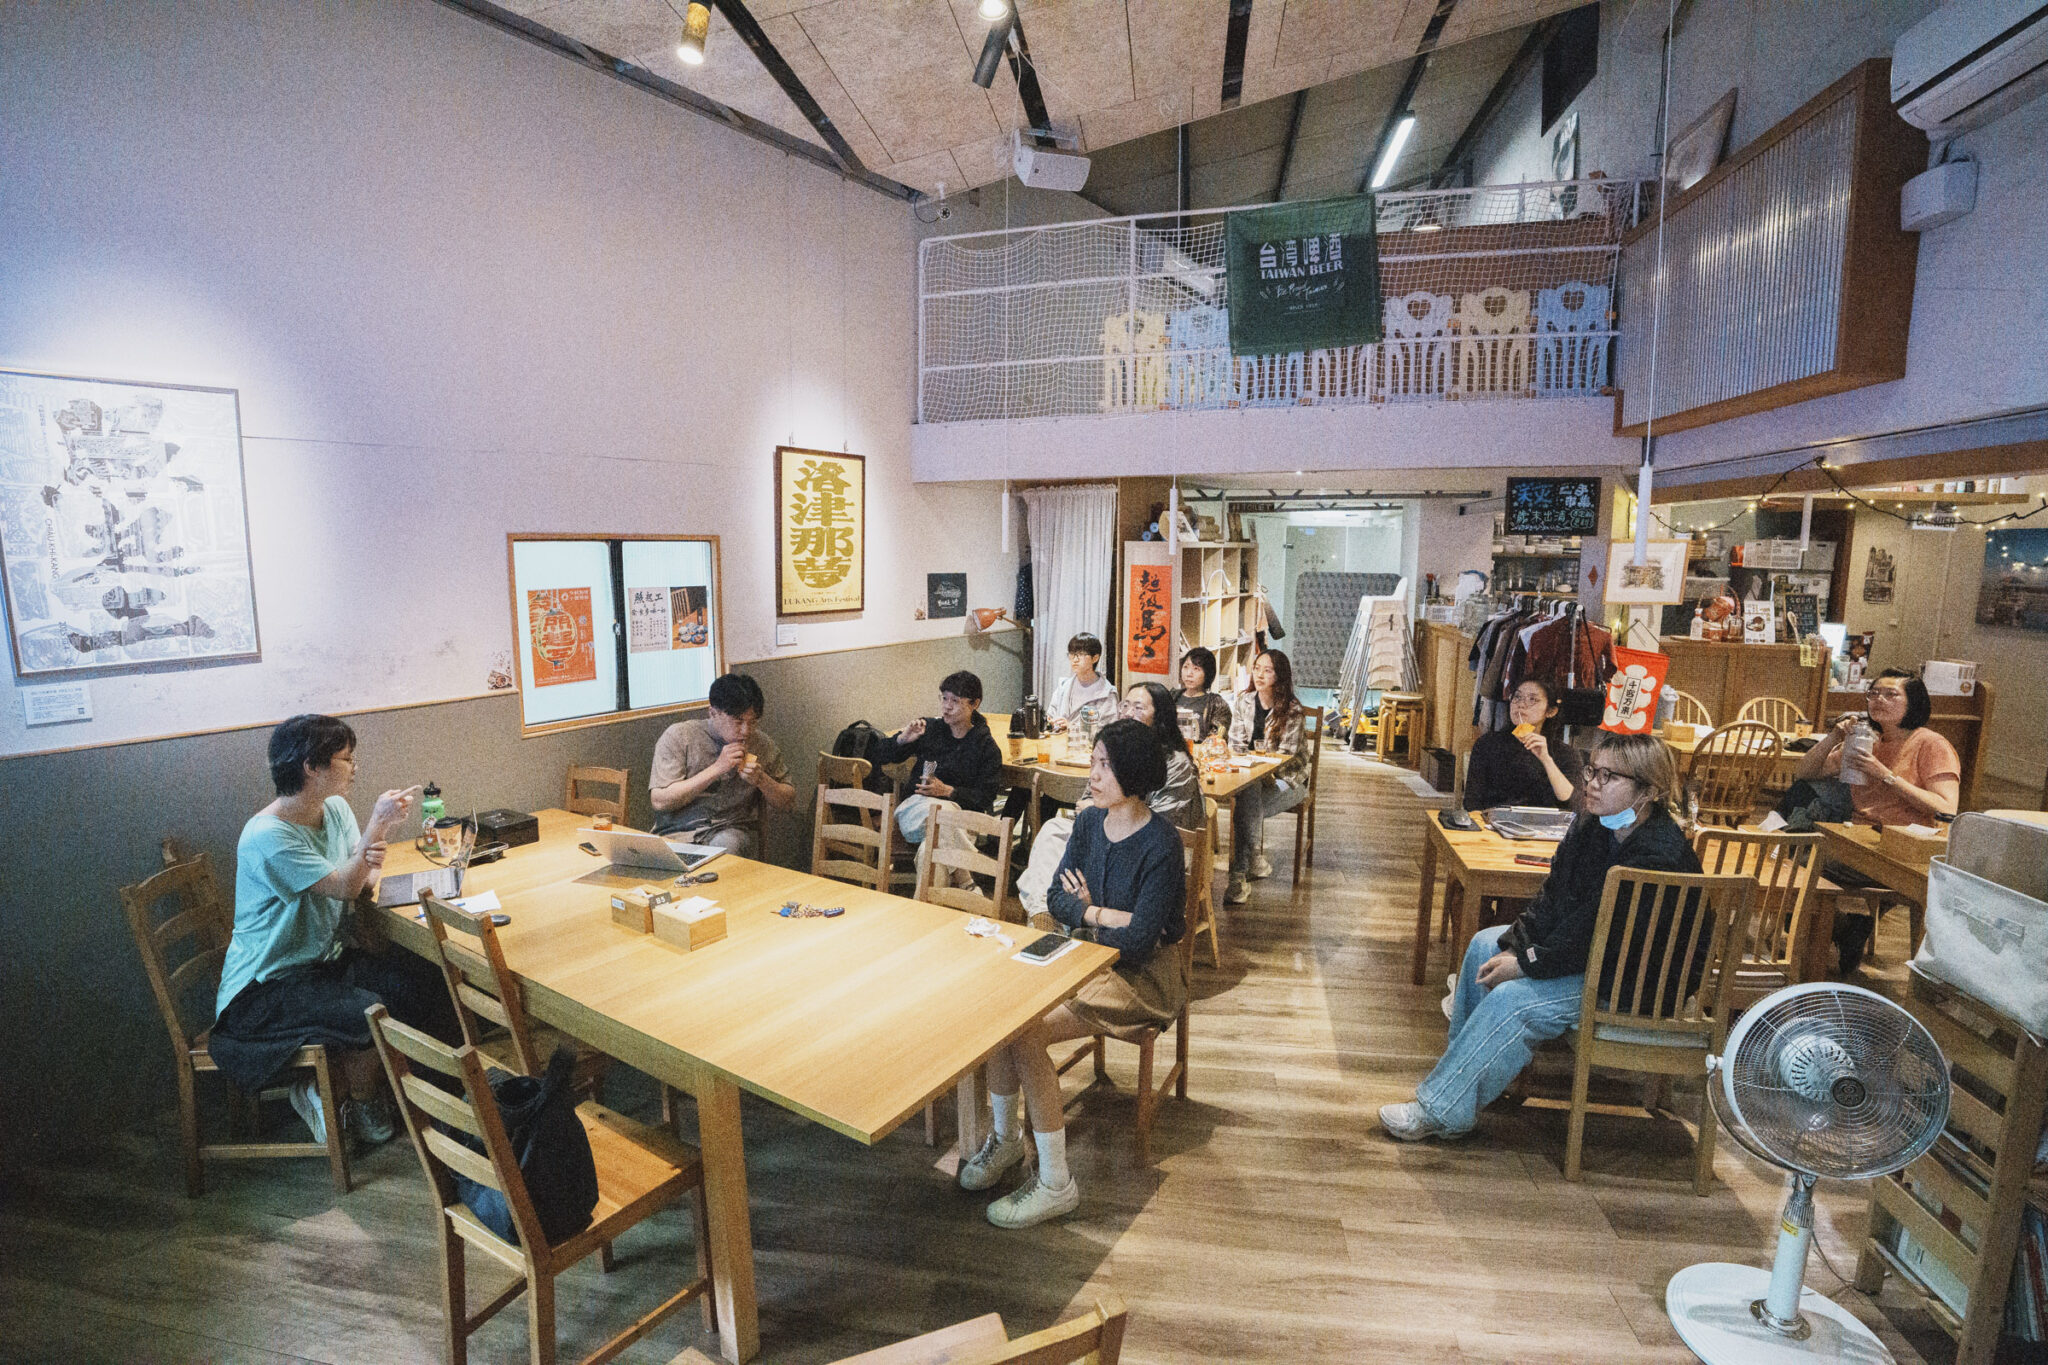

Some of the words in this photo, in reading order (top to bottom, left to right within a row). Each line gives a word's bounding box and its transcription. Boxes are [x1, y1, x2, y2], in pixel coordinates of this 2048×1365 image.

[1260, 233, 1342, 268] 台灣啤酒
[1260, 267, 1305, 279] TAIWAN
[1309, 260, 1343, 276] BEER
[789, 459, 856, 589] 洛津那夢
